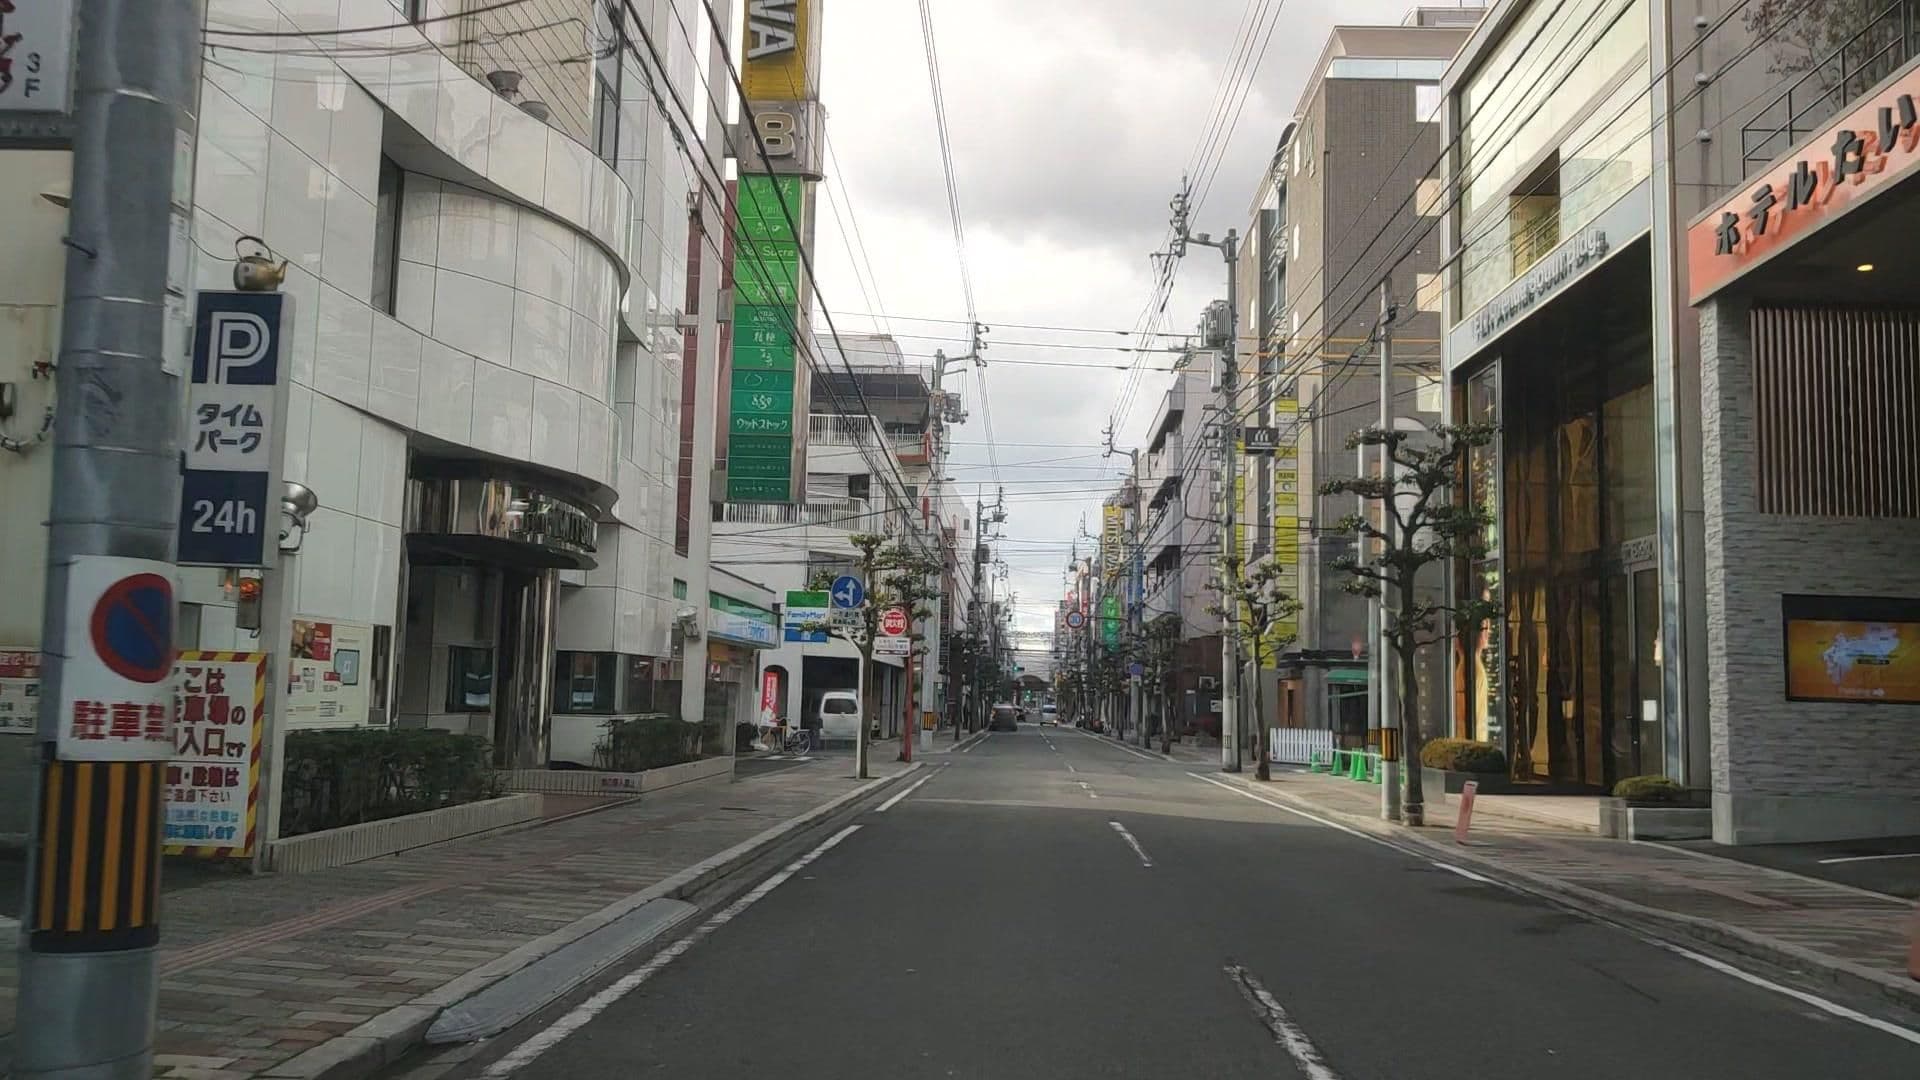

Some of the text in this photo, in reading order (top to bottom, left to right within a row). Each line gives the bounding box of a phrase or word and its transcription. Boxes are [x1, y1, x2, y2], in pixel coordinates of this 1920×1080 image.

[207, 311, 270, 384] P
[196, 403, 263, 427] タイム
[736, 418, 788, 430] ウッドストック
[194, 431, 261, 453] パーク
[191, 500, 256, 534] 24h
